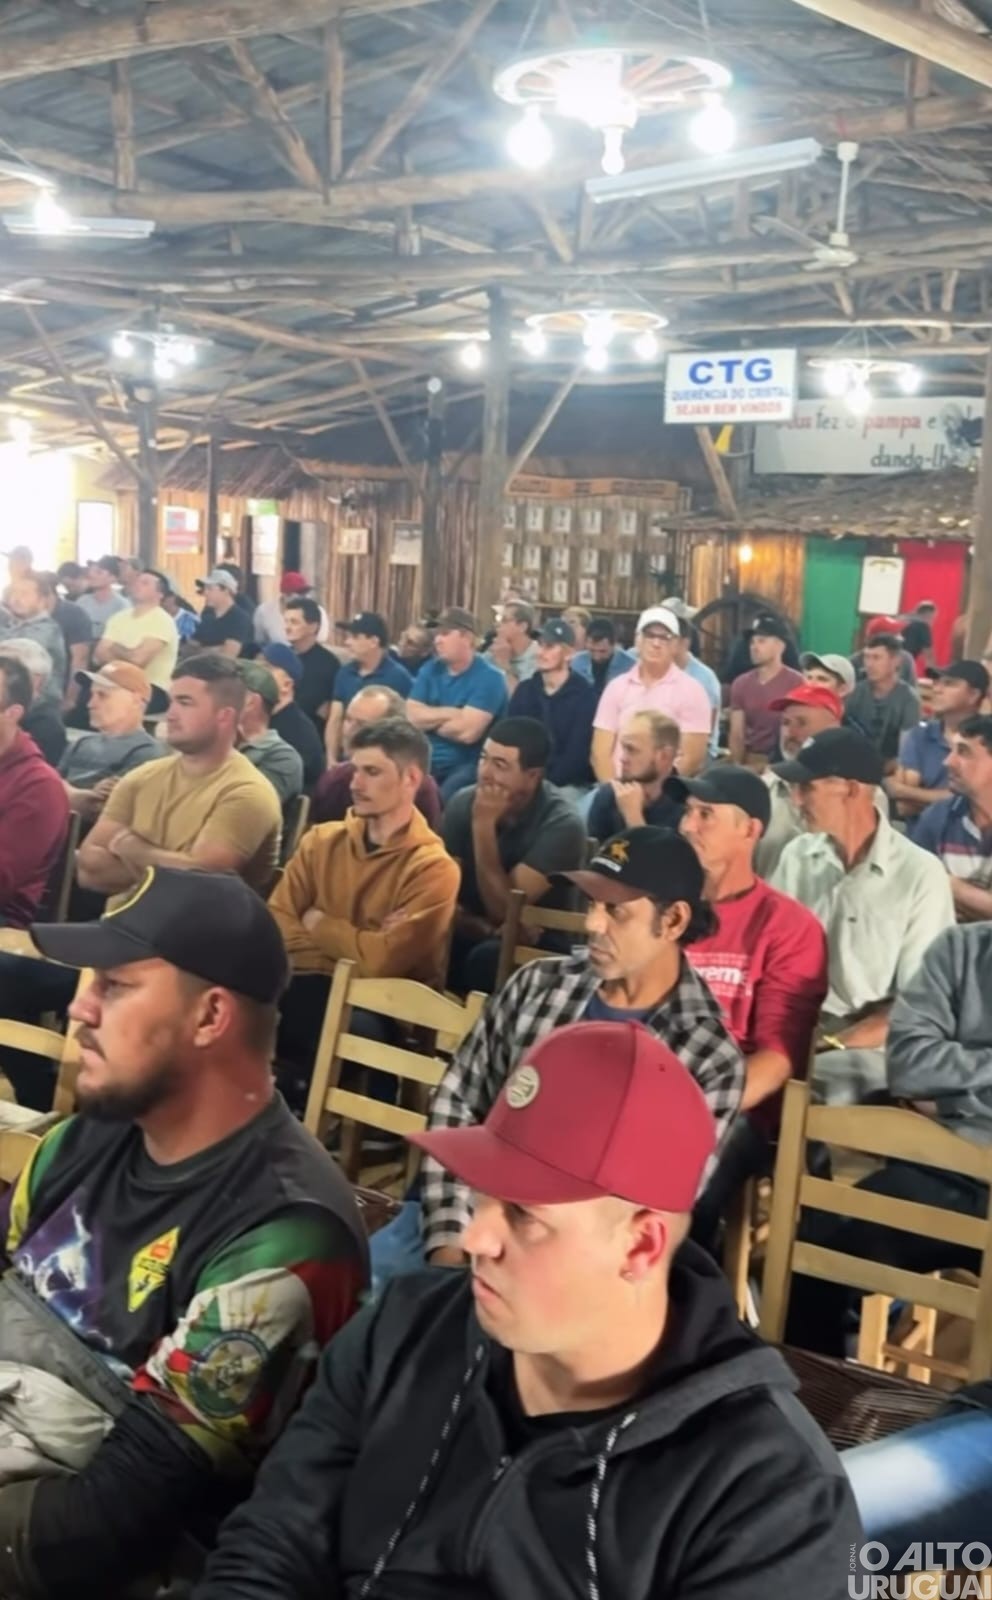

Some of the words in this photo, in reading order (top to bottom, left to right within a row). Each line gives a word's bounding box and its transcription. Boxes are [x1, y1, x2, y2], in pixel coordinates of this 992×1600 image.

[688, 358, 773, 385] CTG
[731, 387, 745, 399] DO
[748, 386, 790, 398] CRISTAL
[675, 404, 711, 416] SEJAM
[714, 403, 736, 414] BEM
[740, 401, 783, 413] VINDOS
[816, 405, 840, 430] fez
[862, 415, 922, 439] pampa
